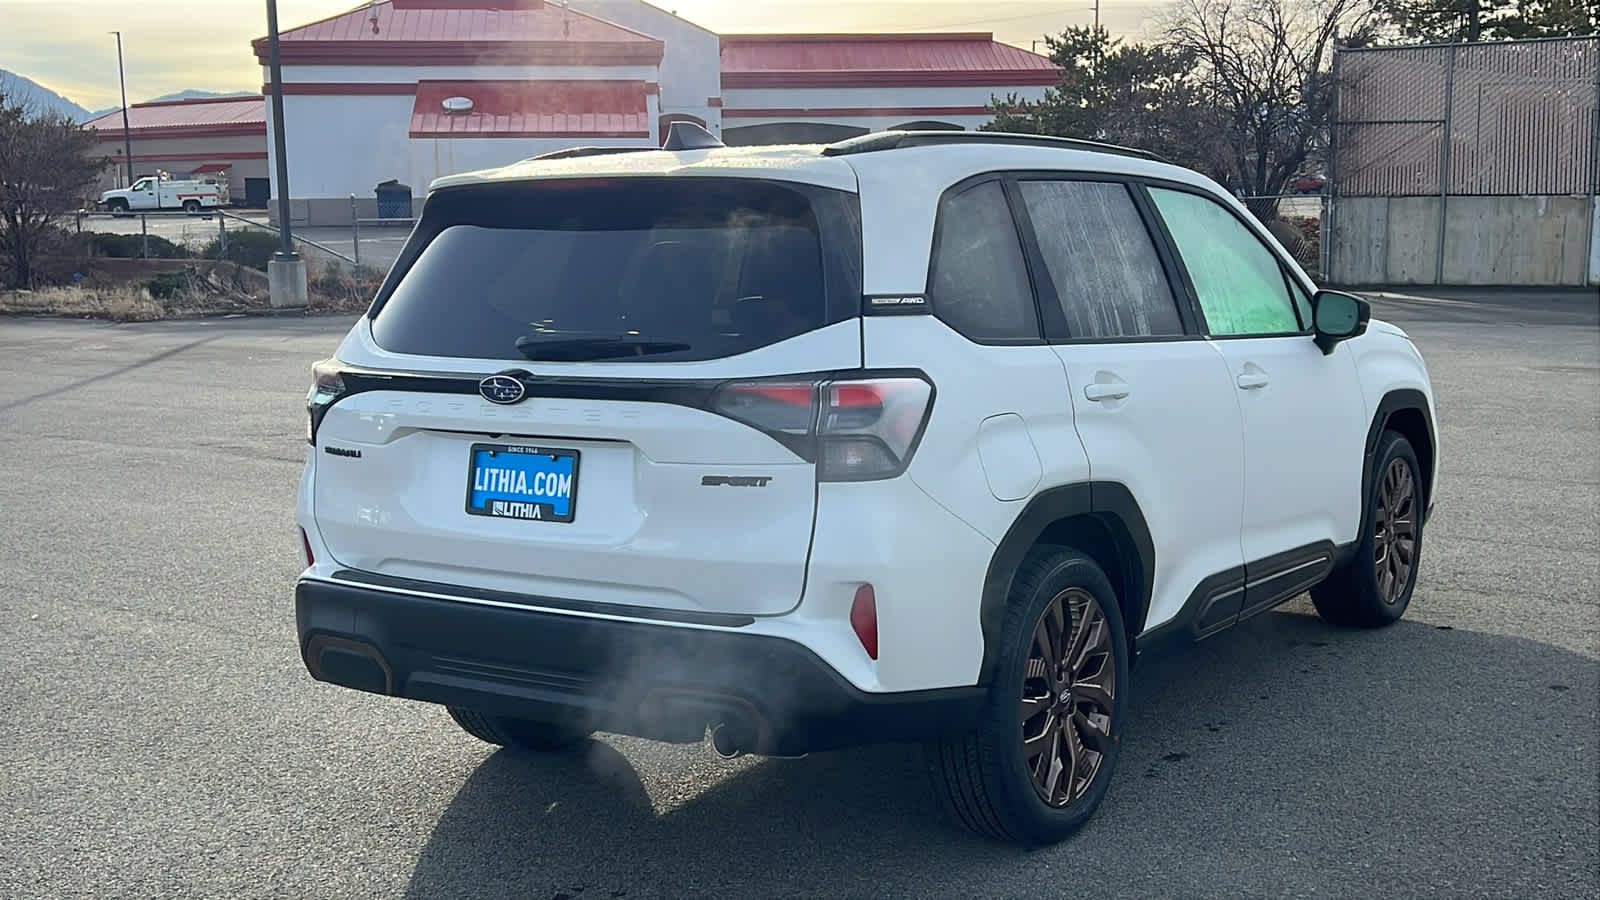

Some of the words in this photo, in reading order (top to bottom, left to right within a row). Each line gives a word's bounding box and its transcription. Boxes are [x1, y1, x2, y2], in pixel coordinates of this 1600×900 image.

[474, 467, 572, 498] LITHIA.COM
[701, 476, 772, 487] SPORT
[503, 502, 541, 519] LITHIA
